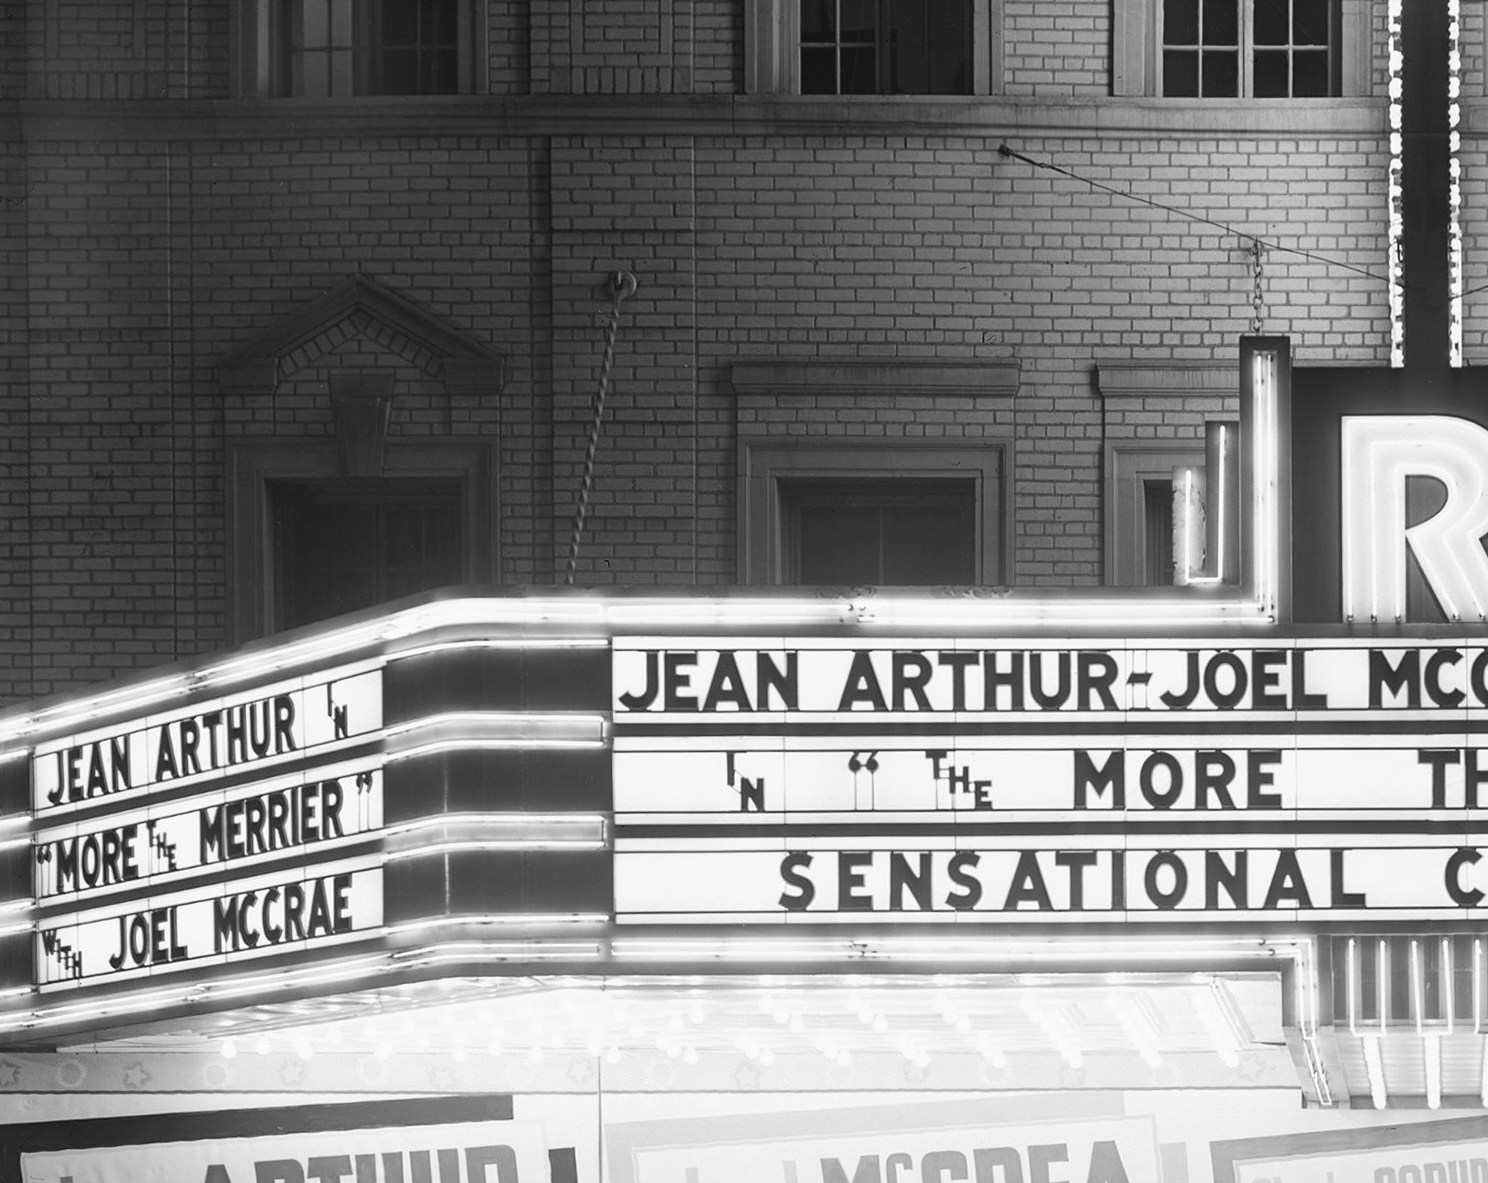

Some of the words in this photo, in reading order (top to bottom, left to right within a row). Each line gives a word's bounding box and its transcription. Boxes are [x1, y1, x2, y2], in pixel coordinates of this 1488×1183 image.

[618, 650, 800, 712] JEAN
[47, 733, 133, 805] JEAN
[154, 693, 296, 783] ARTHUR
[327, 682, 348, 739] IN
[726, 751, 765, 812] IN
[925, 750, 994, 811] THE
[1073, 750, 1283, 811] MORE
[147, 820, 177, 870] THE
[779, 850, 1367, 912] SENSATIONAL
[42, 929, 82, 979] WITH
[109, 906, 189, 972] JOEL
[213, 873, 354, 955] MCCRAE
